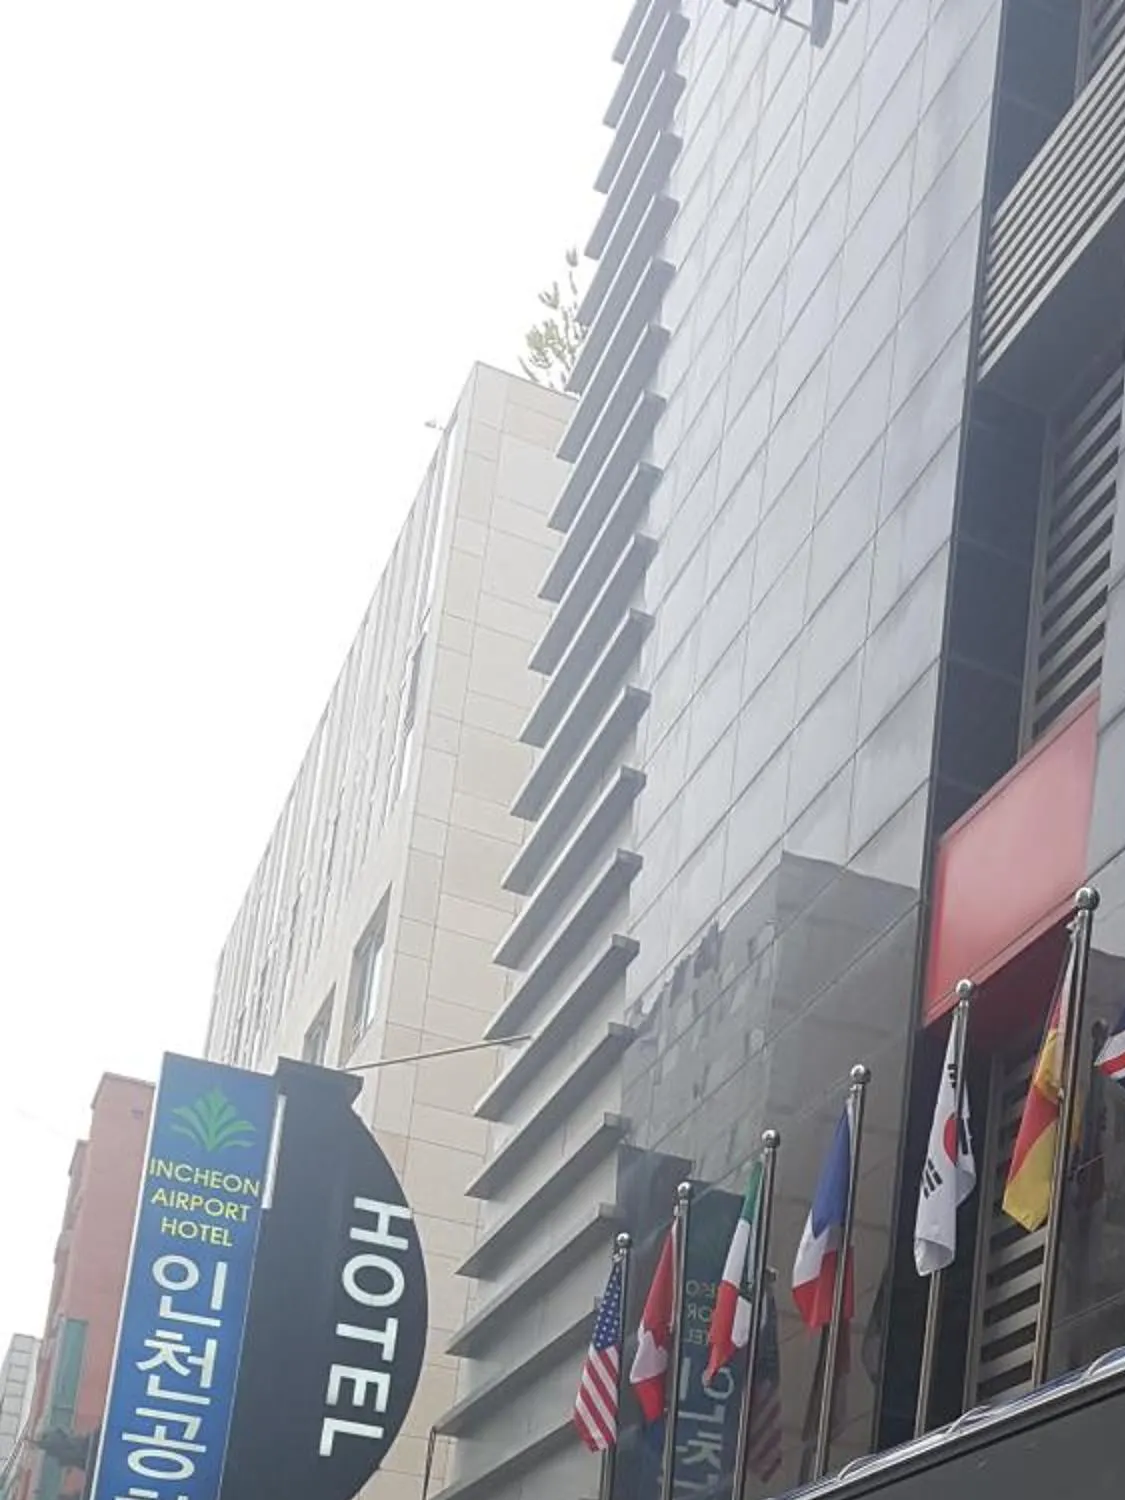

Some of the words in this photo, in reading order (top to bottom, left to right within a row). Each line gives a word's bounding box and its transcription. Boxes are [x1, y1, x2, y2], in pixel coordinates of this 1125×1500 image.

[149, 1157, 260, 1197] INCHEON
[151, 1187, 251, 1222] AIRPORT
[160, 1215, 233, 1247] HOTEL
[319, 1195, 412, 1457] HOTEL
